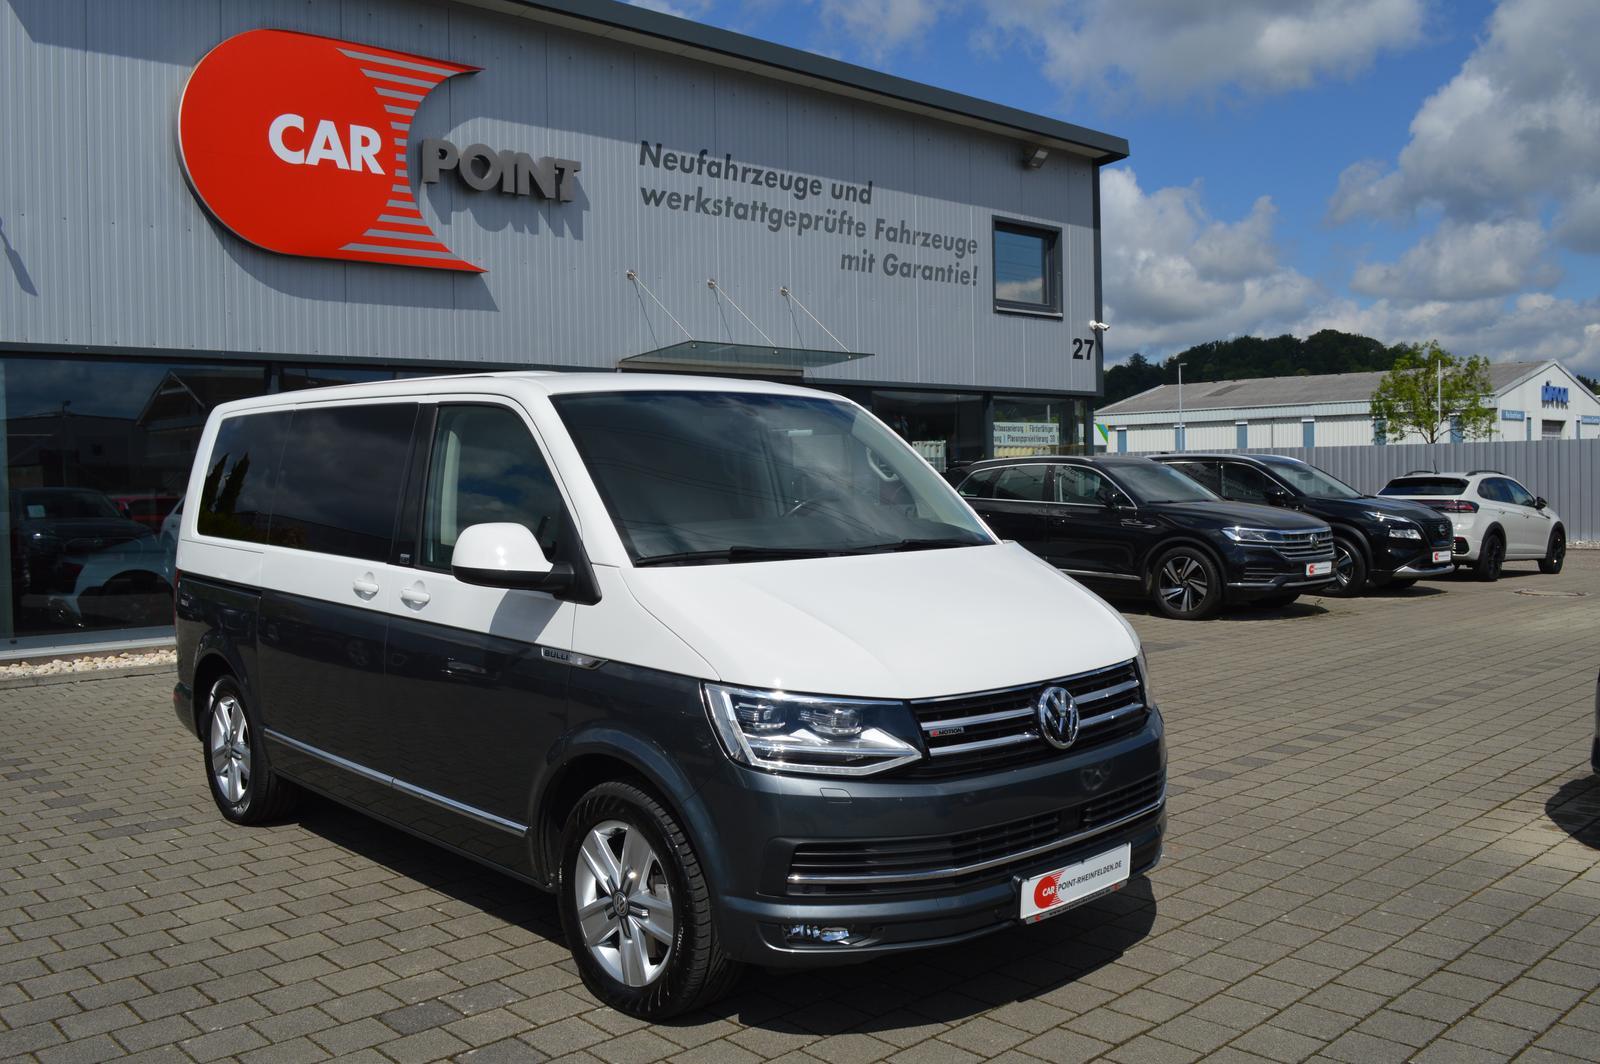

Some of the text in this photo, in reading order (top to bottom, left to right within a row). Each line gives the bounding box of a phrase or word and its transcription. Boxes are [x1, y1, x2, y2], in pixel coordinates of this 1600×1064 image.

[268, 113, 581, 202] CAR POINT
[639, 140, 873, 205] Neufahrzeuge und
[640, 186, 978, 257] werkstattgeprüfte Fahrzeuge
[841, 250, 978, 286] mit Garantie!
[1072, 338, 1095, 360] 27
[544, 649, 569, 660] BULLI
[1042, 860, 1122, 897] CAR POINT-RHEINFELDEN.DE
